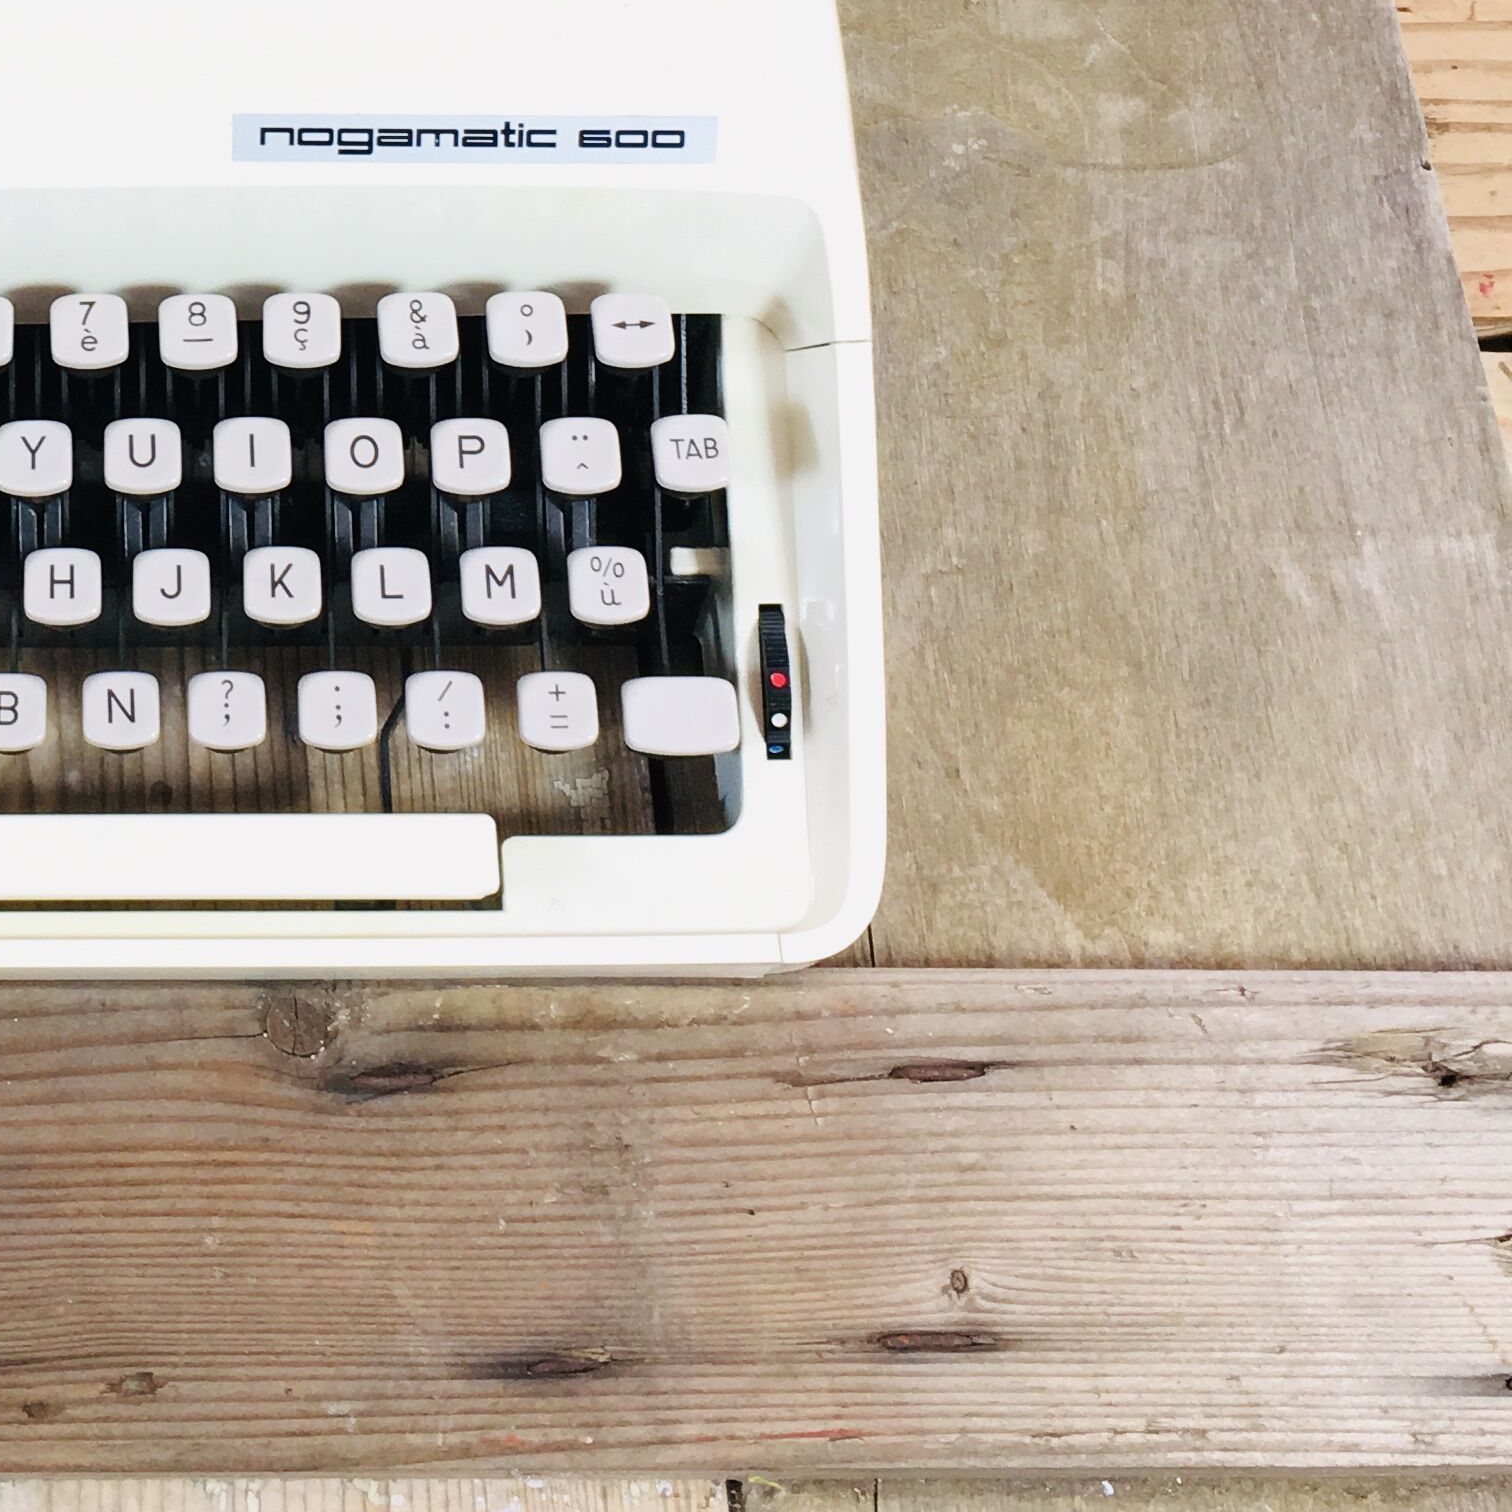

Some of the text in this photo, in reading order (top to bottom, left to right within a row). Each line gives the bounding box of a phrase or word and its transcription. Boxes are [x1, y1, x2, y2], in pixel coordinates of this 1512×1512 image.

[260, 122, 685, 155] nogamatic 600
[80, 301, 96, 325] 7
[189, 302, 206, 326] 8
[293, 301, 310, 324] 9
[409, 299, 427, 324] &
[81, 329, 98, 351] è
[294, 328, 307, 350] ç
[412, 326, 429, 349] à
[525, 329, 533, 346] )
[21, 436, 45, 469] Y
[129, 434, 155, 467] U
[250, 434, 255, 467] I
[350, 435, 378, 468] O
[459, 435, 485, 468] P
[670, 438, 718, 459] TAB
[590, 556, 625, 579] %
[50, 565, 74, 599] H
[161, 565, 181, 599] J
[271, 564, 293, 597] K
[380, 565, 403, 599] L
[486, 565, 515, 598] M
[601, 583, 621, 605] ù
[221, 679, 234, 708] ?
[437, 680, 453, 702] /
[548, 684, 566, 702] +
[108, 689, 135, 723] N
[443, 711, 450, 730] :
[549, 714, 569, 729] =
